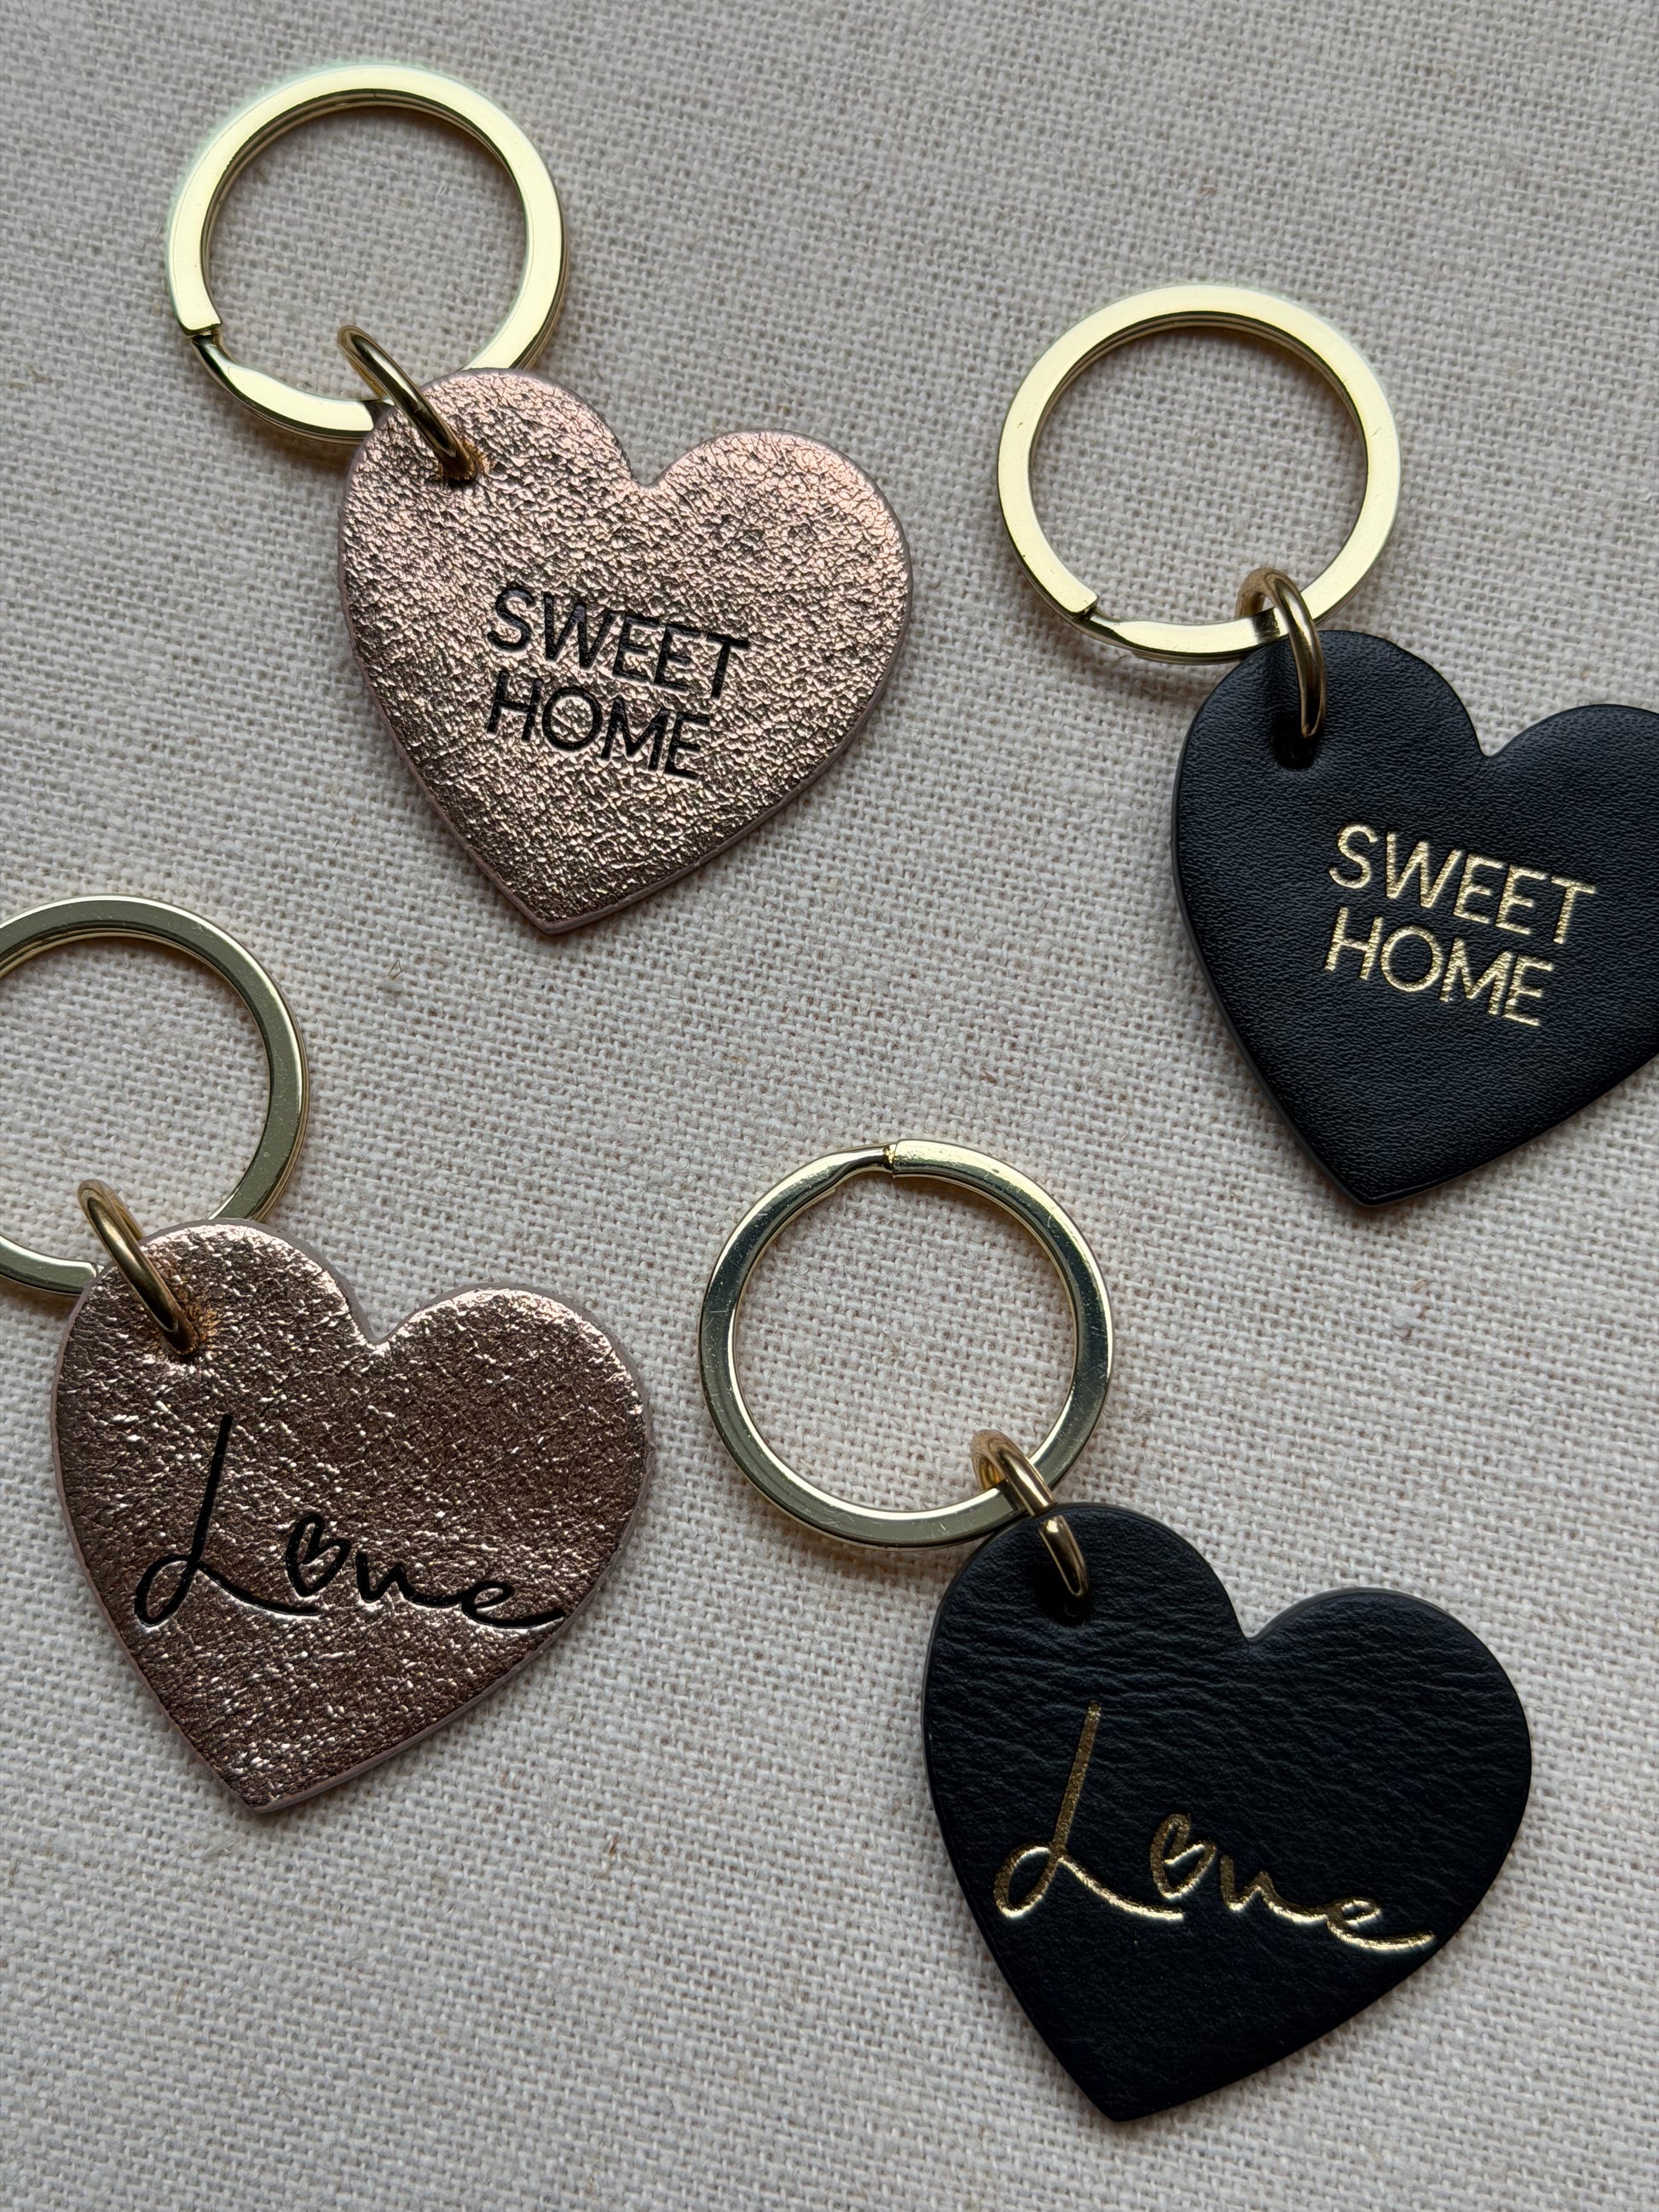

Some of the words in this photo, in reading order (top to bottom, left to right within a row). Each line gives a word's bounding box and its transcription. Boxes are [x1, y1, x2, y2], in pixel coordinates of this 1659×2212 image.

[487, 585, 749, 700] SWEET
[487, 670, 710, 780] HOME
[1328, 823, 1596, 944] SWEET
[1324, 906, 1553, 1026] HOME
